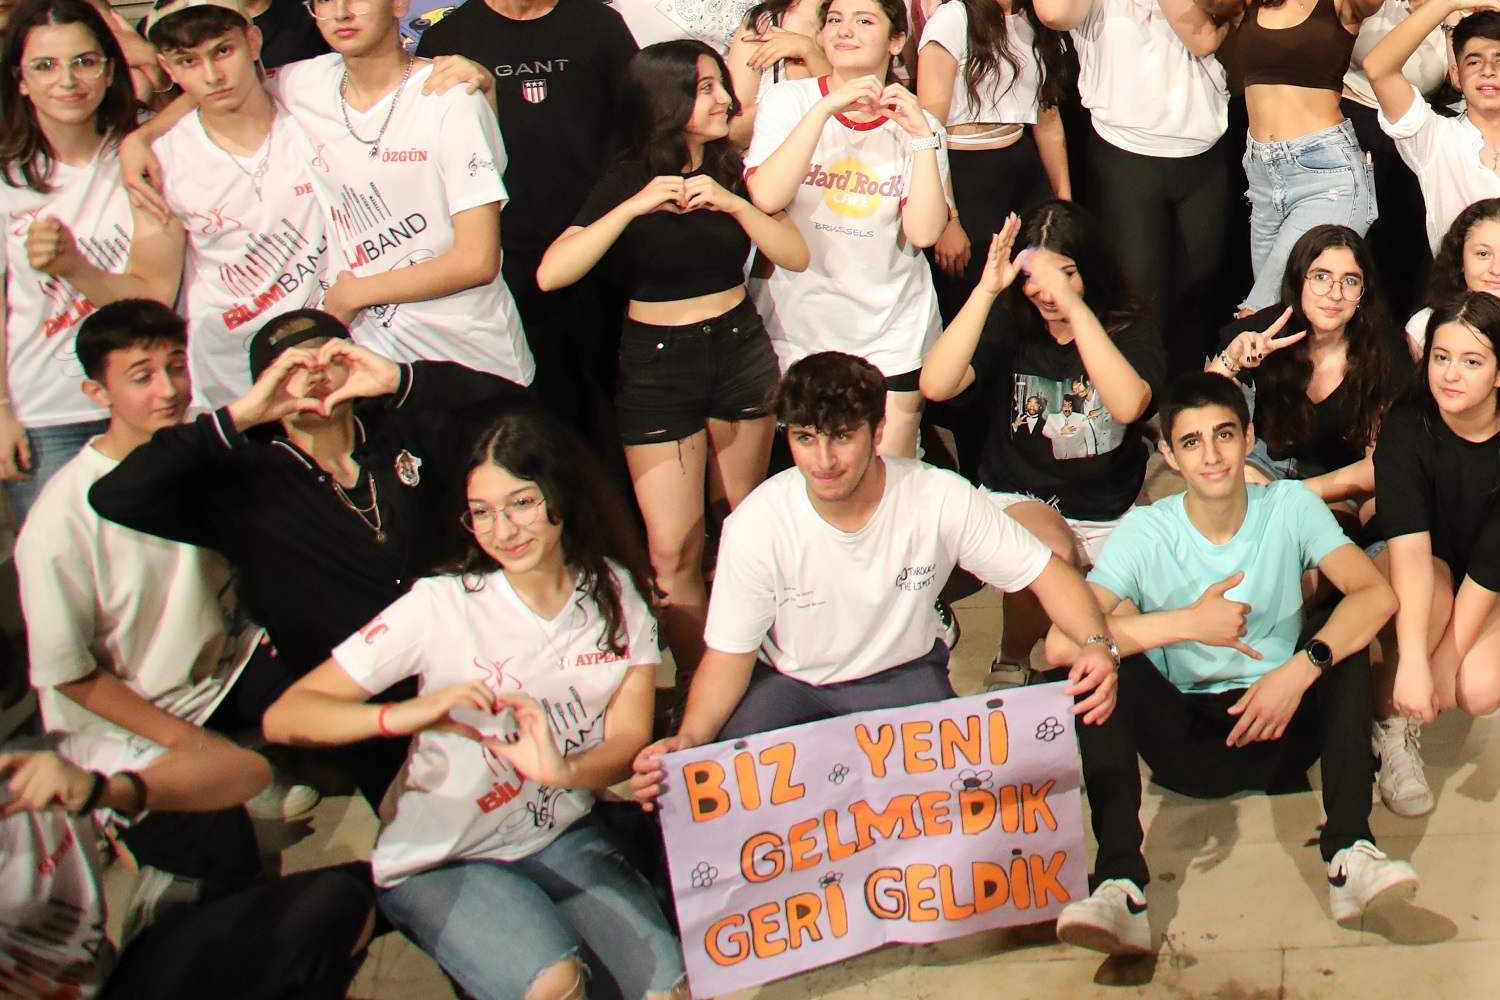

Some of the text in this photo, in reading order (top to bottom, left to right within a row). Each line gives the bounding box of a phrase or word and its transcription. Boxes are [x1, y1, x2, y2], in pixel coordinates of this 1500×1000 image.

[494, 58, 569, 77] GANT
[382, 148, 428, 163] ÖZGÜN
[800, 162, 902, 198] Hard Rock
[833, 191, 869, 209] CAFE
[814, 221, 874, 238] BRUSSELS
[682, 698, 1010, 824] BİZ YENİ
[863, 848, 1072, 923] GELDİK
